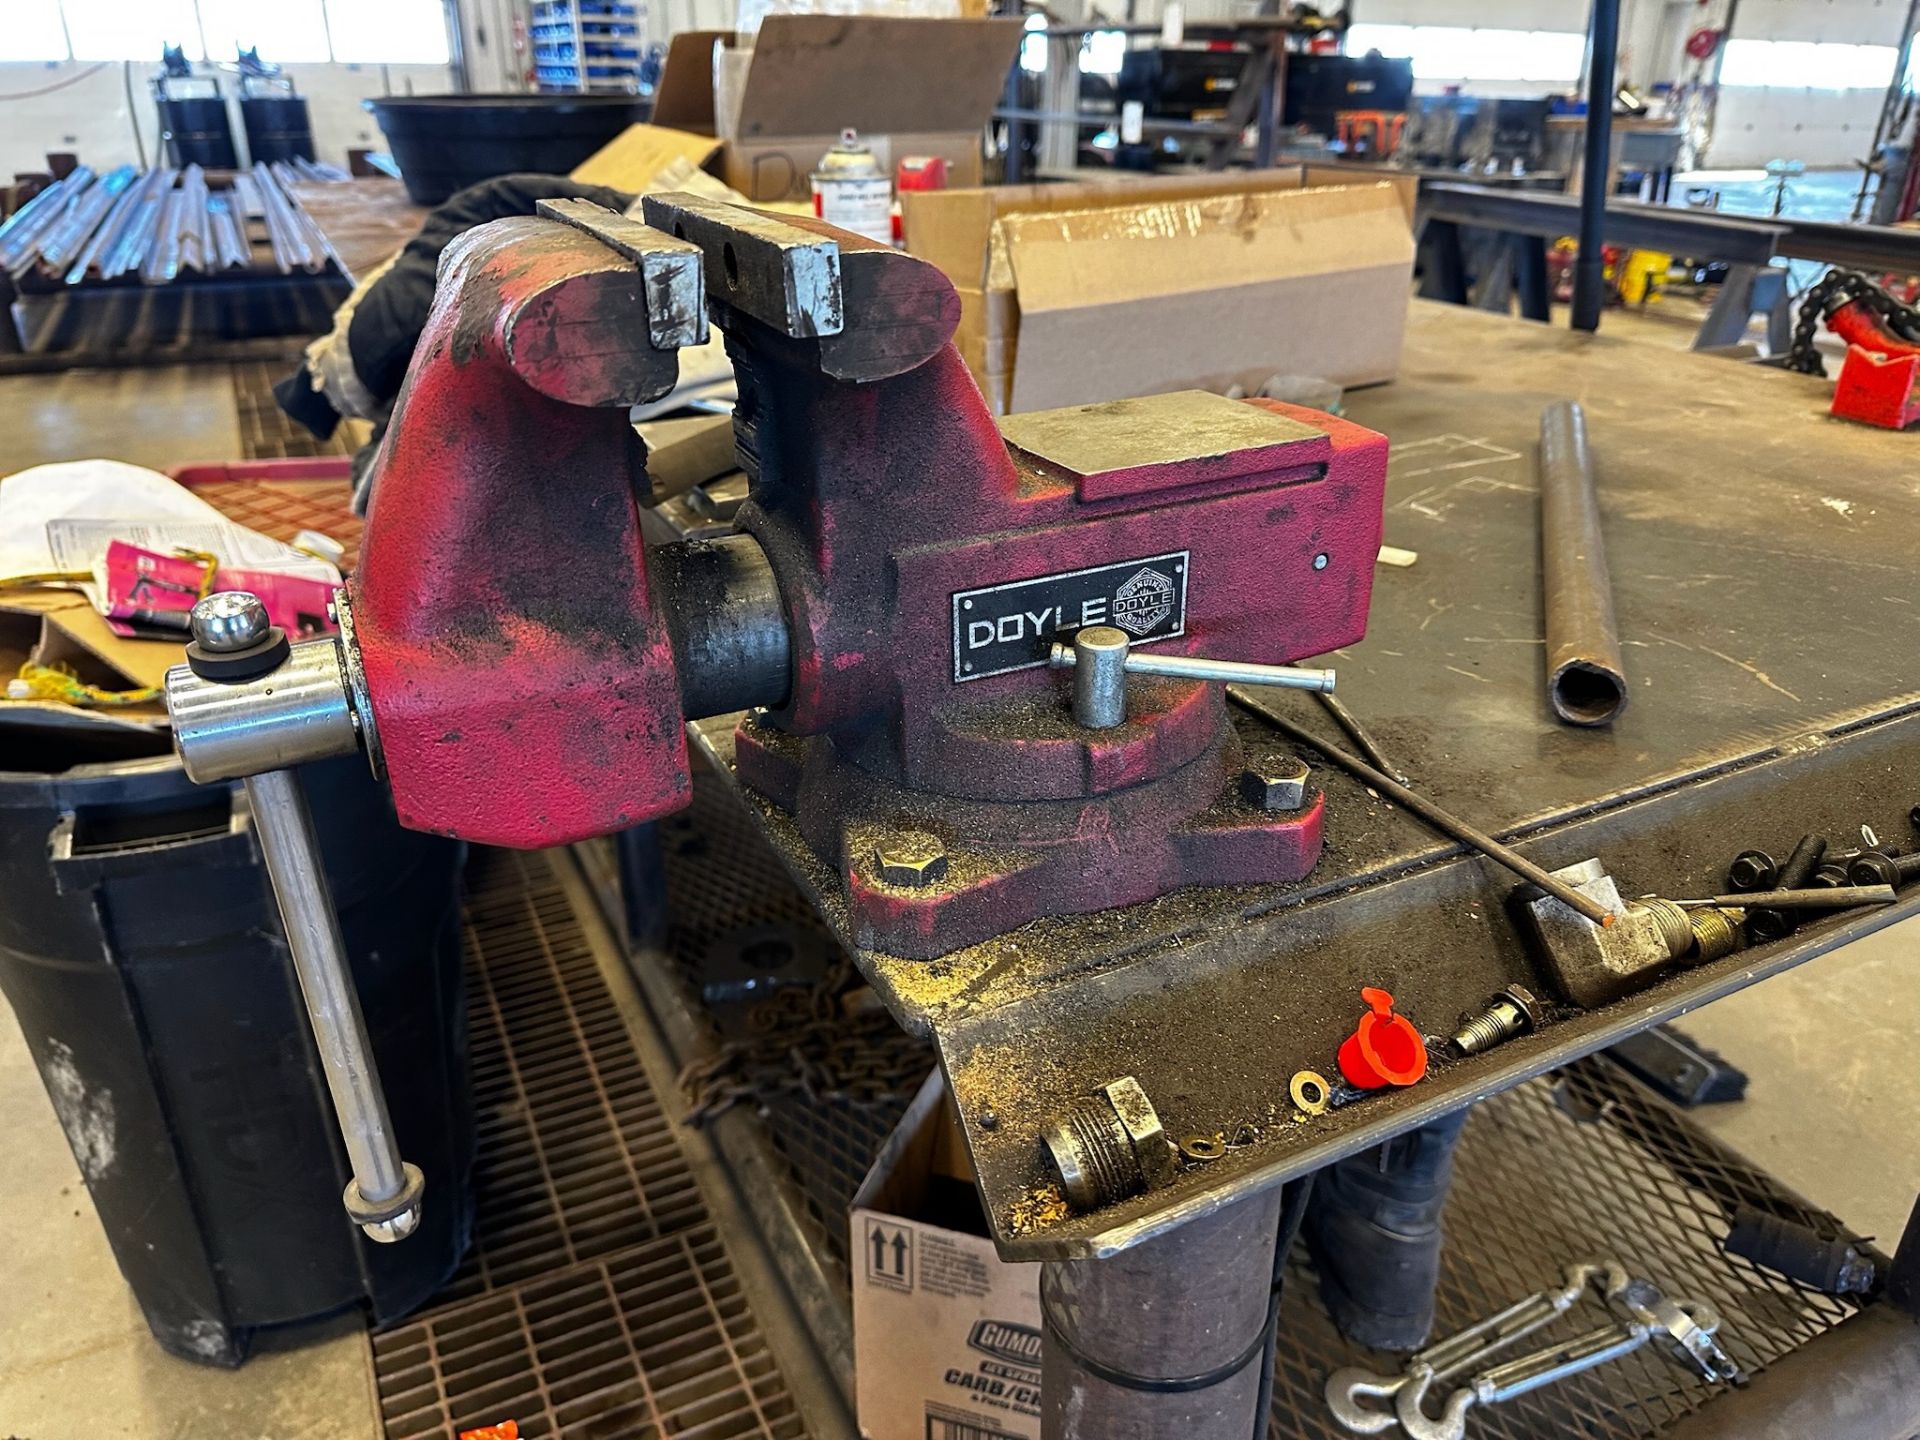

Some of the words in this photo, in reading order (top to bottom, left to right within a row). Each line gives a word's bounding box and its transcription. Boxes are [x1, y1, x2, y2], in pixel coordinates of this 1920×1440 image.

[1116, 591, 1172, 612] DOYLE
[1126, 579, 1162, 597] GENUINE
[969, 597, 1107, 650] DOYLE
[1127, 608, 1160, 624] QUALITY
[980, 1323, 1042, 1357] GUMO
[945, 1368, 1042, 1406] CARB/CH
